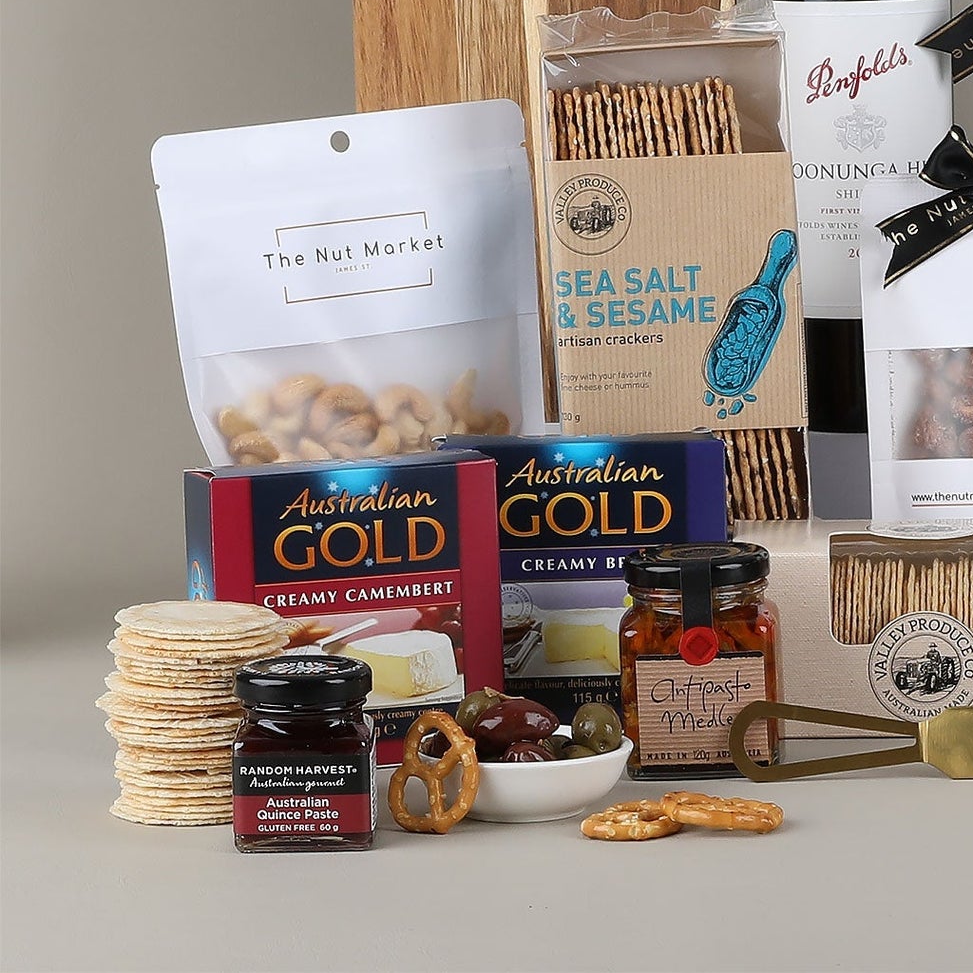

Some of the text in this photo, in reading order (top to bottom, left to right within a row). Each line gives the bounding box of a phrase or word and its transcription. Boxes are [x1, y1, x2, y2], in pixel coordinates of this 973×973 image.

[806, 42, 908, 104] Penfolds
[555, 178, 624, 225] VALLEY PRODUCE
[836, 189, 860, 199] SHI
[890, 222, 919, 246] he
[263, 234, 444, 269] The Nut Market
[556, 265, 702, 298] SEA SALT
[557, 296, 716, 329] & SESAME
[558, 332, 664, 348] artisan crackers
[574, 383, 602, 391] cheese
[615, 382, 650, 391] hummus
[579, 371, 597, 380] with
[599, 372, 616, 382] your
[617, 370, 653, 379] favourite
[505, 454, 664, 487] Australian
[279, 481, 438, 521] Australian
[500, 490, 673, 537] GOLD
[273, 516, 446, 571] GOLD
[521, 557, 597, 572] CREAMY
[263, 581, 454, 609] CREAMY CAMEMBERT
[874, 623, 908, 681] VALLEY
[908, 618, 973, 657] PRODUCE
[567, 677, 612, 689] deliciously
[883, 689, 942, 717] AUSTRALIAN
[387, 710, 415, 721] creamy
[239, 765, 292, 776] RANDOM
[249, 777, 346, 792] Australian gourmet
[266, 796, 330, 808] Australian
[257, 809, 339, 821] Quince Paste
[258, 824, 292, 832] GLUTEN
[319, 824, 332, 832] 60
[333, 825, 339, 833] g
